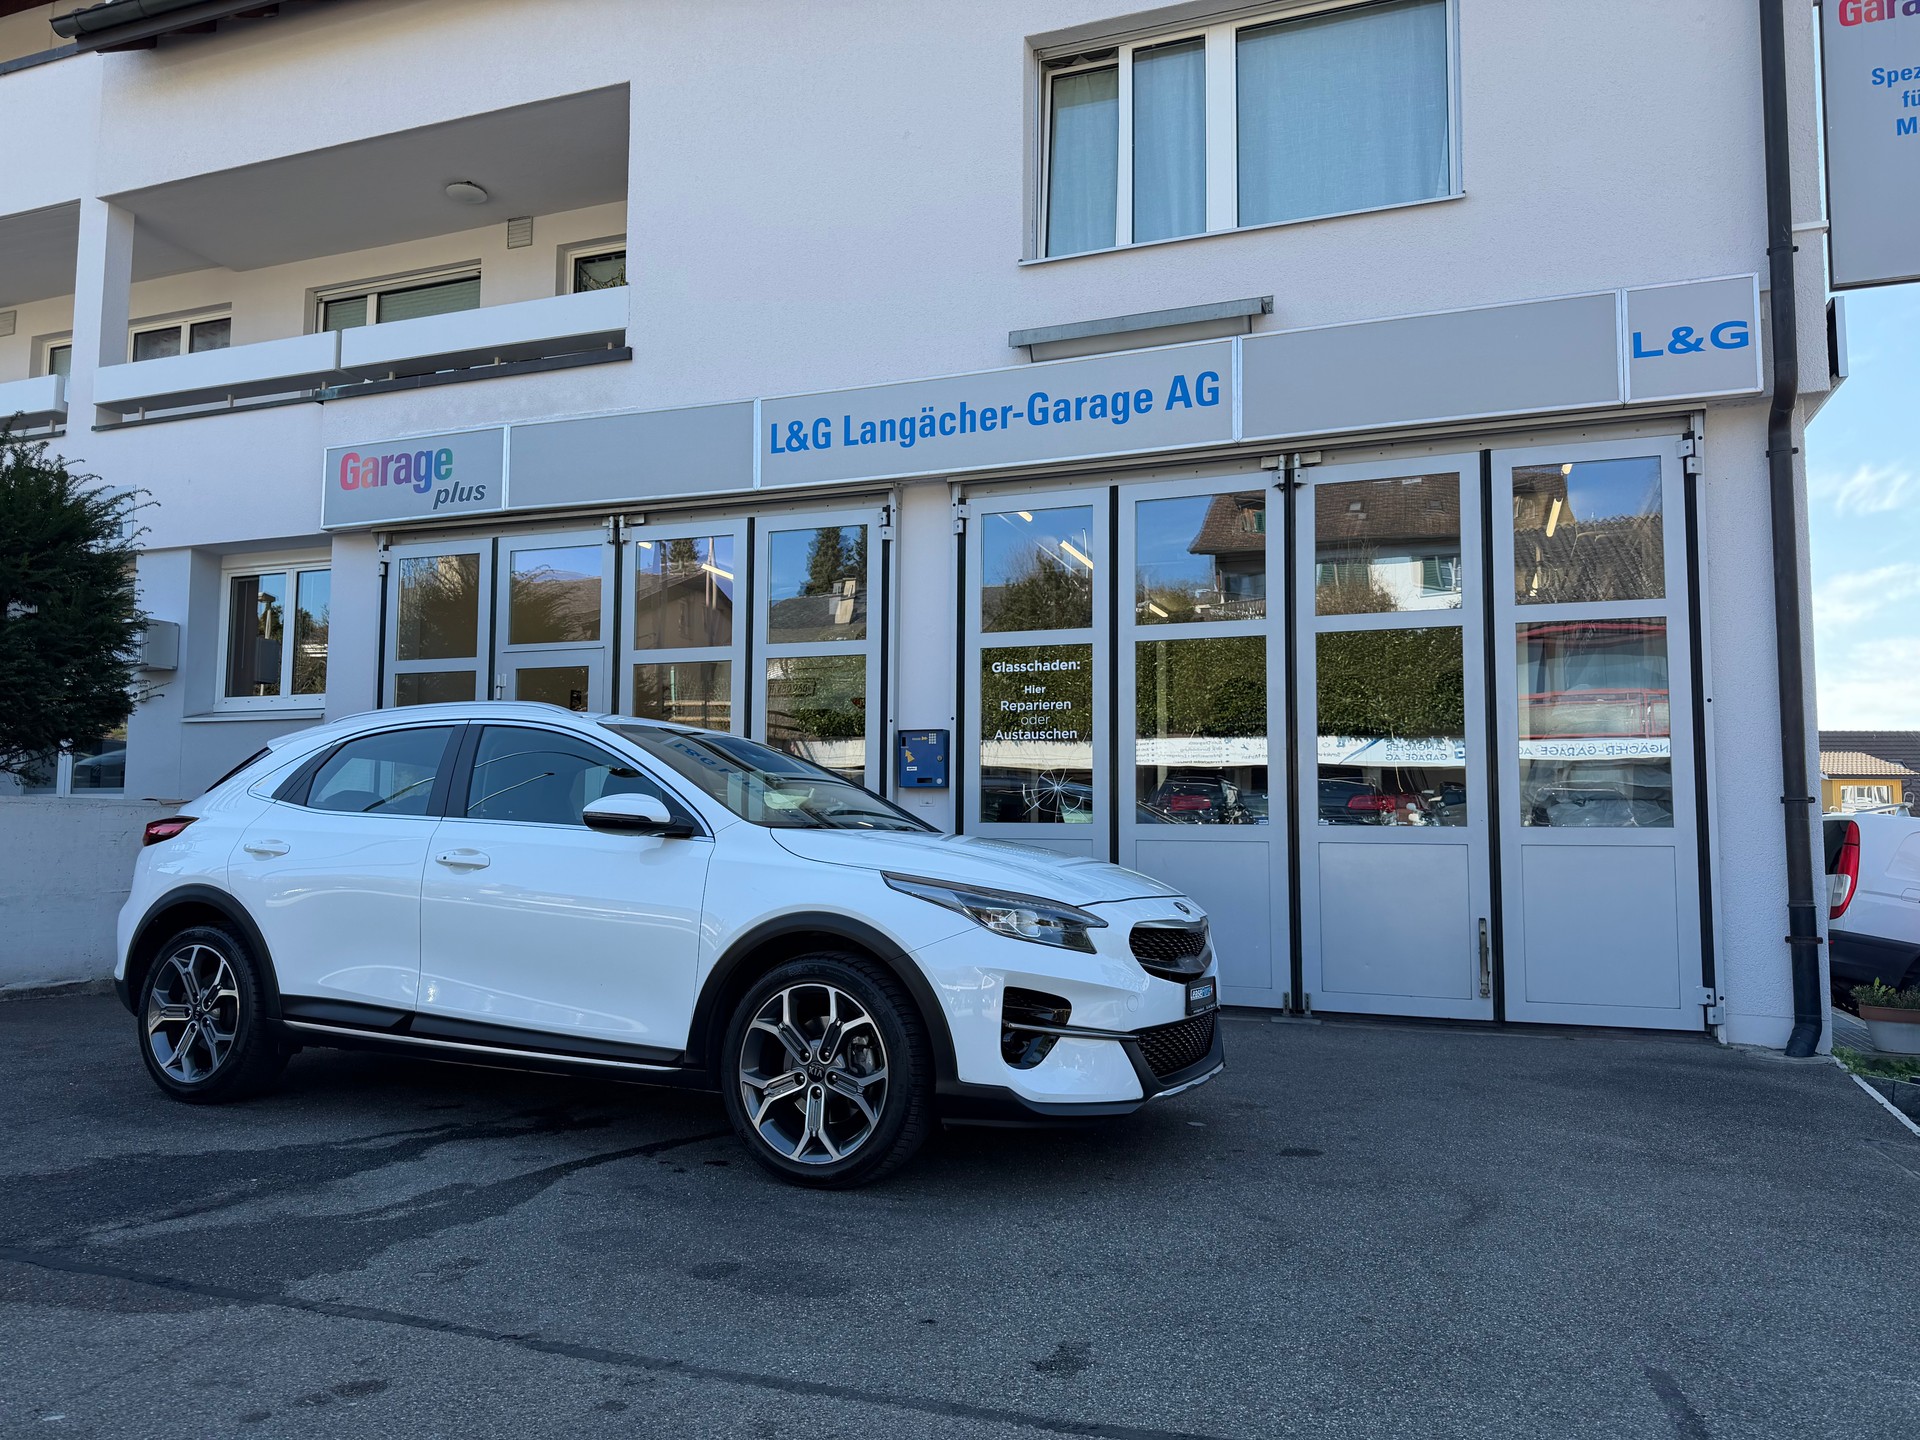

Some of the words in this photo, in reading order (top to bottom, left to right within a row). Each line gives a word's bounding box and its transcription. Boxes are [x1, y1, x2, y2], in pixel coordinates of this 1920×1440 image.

[1896, 116, 1920, 136] M
[1633, 320, 1750, 359] L&G
[771, 417, 832, 454] L&G
[844, 388, 1153, 448] Langächer-Garage
[1165, 371, 1220, 410] AG
[340, 447, 453, 494] Garage
[432, 481, 487, 510] plus
[991, 660, 1081, 673] Glasschaden:
[1024, 685, 1046, 694] Hier
[1000, 700, 1072, 713] Reparieren
[1020, 714, 1051, 726] oder
[994, 728, 1078, 740] Austauschen
[808, 1065, 824, 1078] KIA
